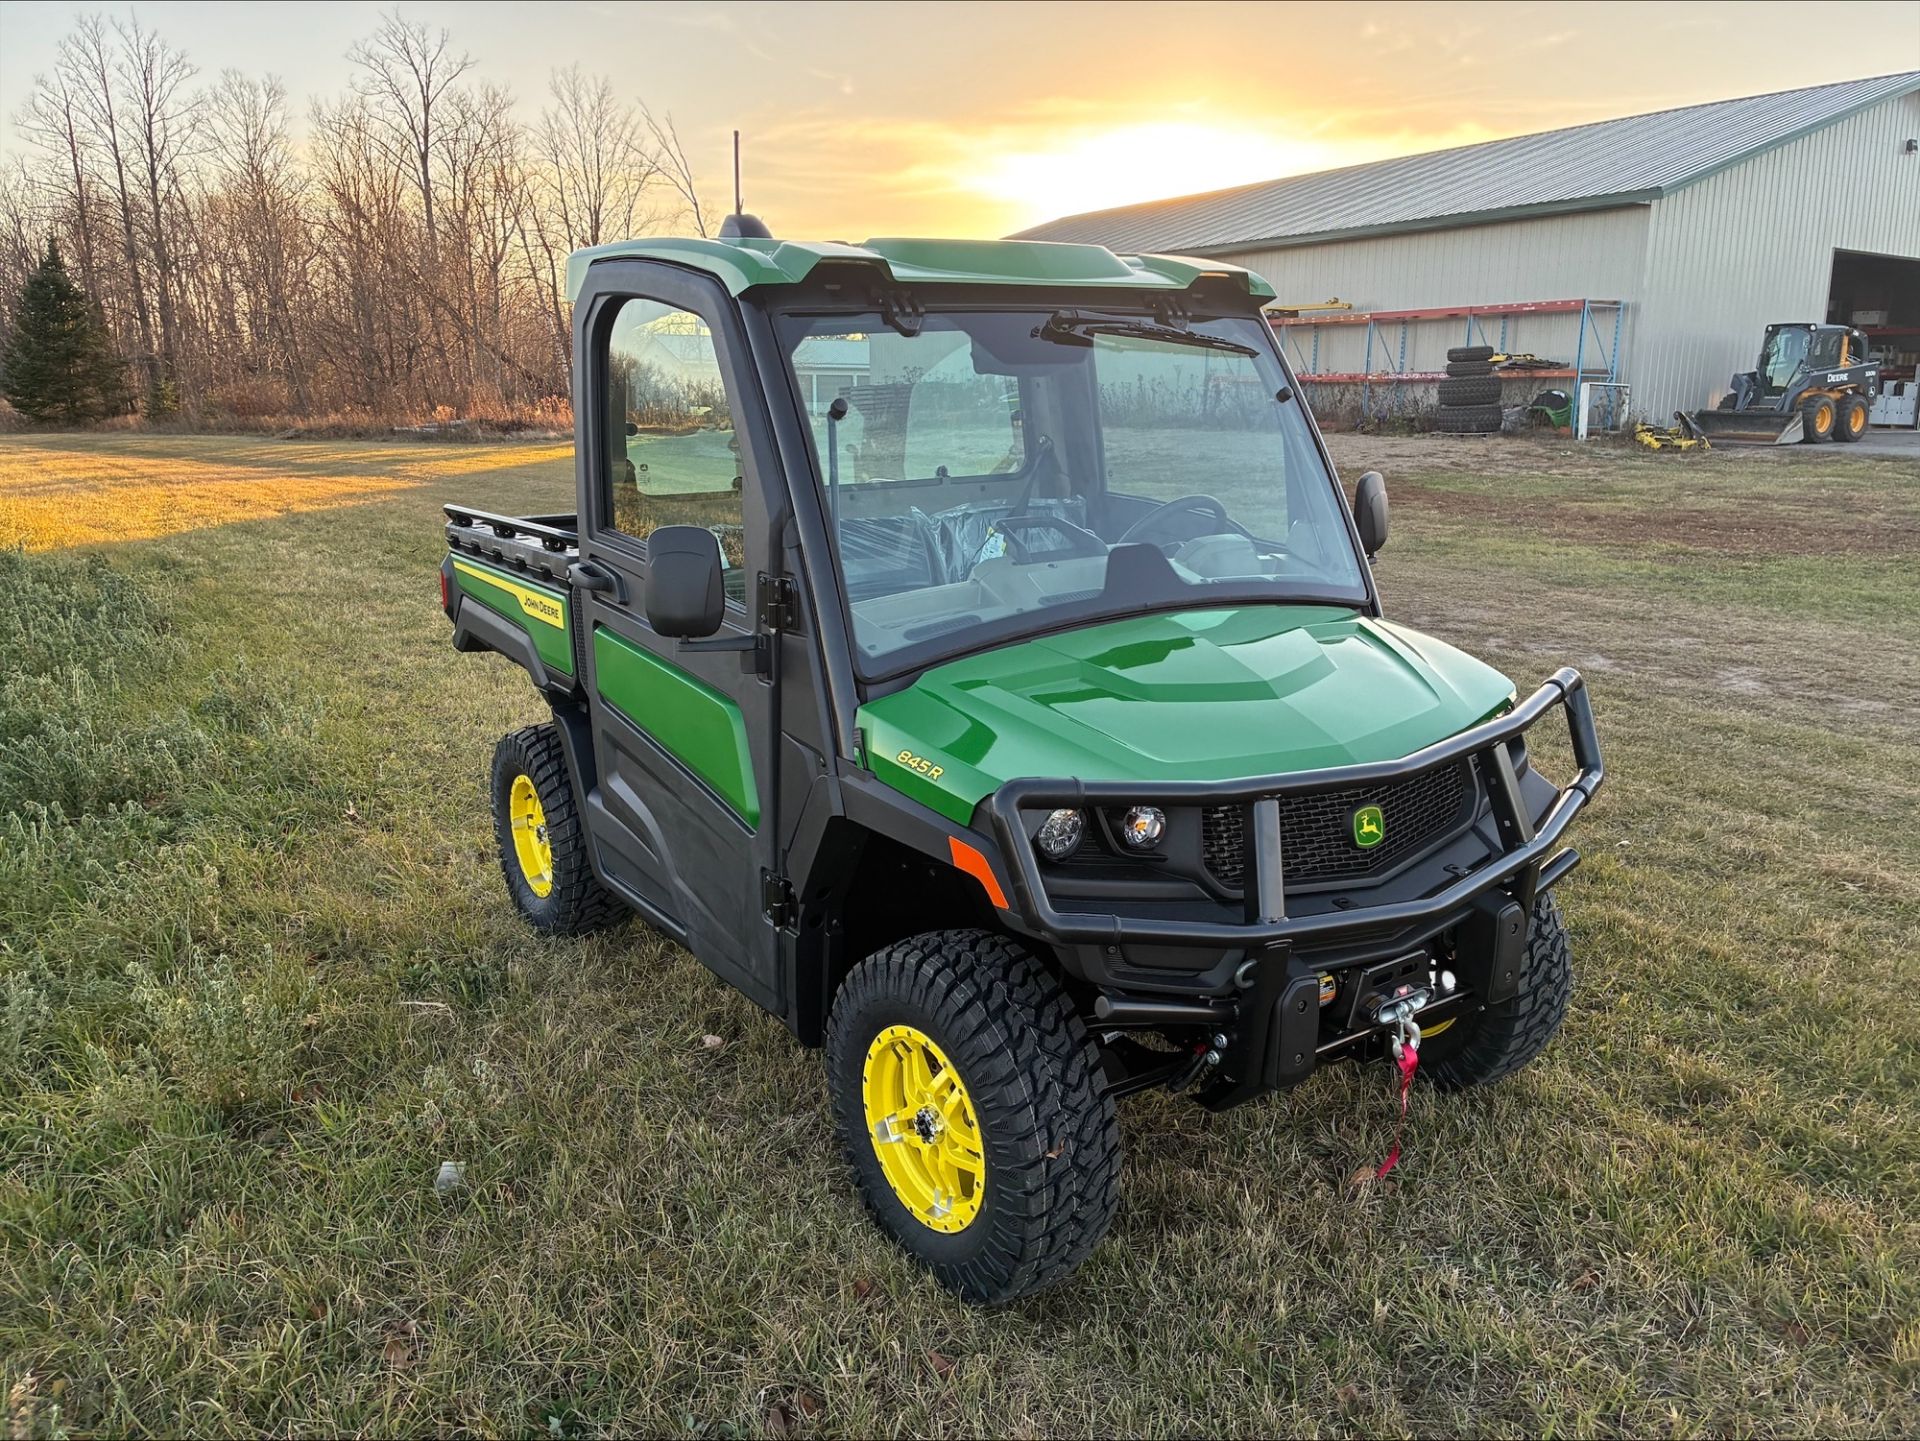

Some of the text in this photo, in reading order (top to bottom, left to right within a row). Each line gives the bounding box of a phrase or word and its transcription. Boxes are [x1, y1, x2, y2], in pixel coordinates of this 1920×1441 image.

[1827, 373, 1848, 382] DEERE
[524, 594, 559, 618] JOHN DEERE
